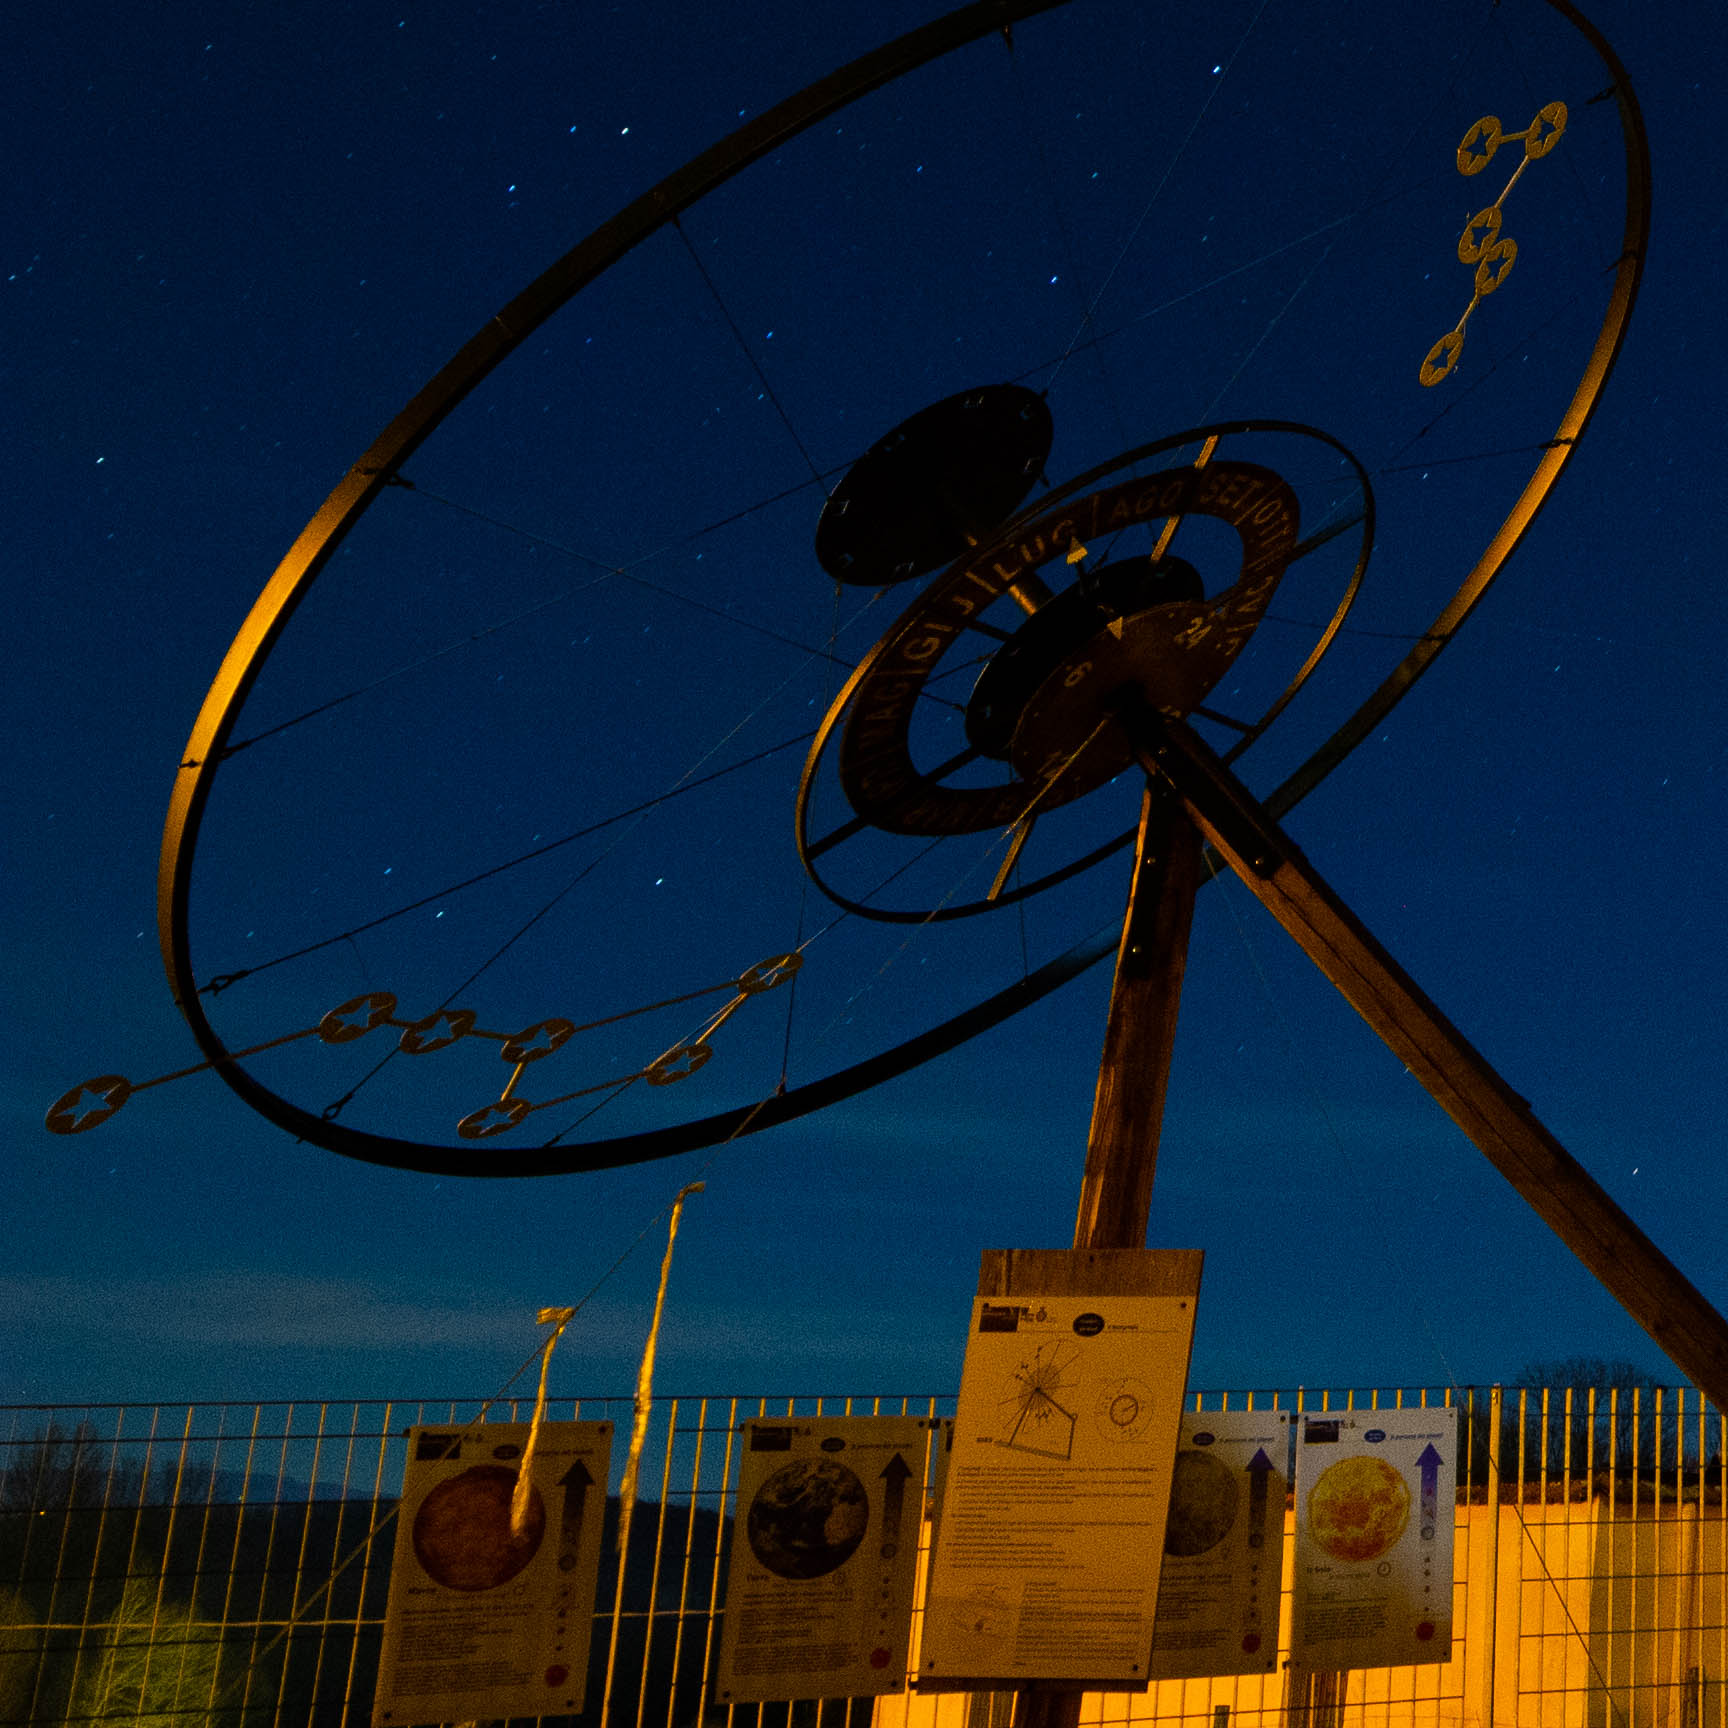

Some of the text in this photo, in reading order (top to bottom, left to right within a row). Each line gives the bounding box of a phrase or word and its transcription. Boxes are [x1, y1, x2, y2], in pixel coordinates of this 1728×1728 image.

[1110, 479, 1186, 523] AGO
[1198, 471, 1265, 510] SET
[992, 518, 1077, 583] LUG
[1174, 614, 1212, 651] 24
[1063, 660, 1093, 687] 6
